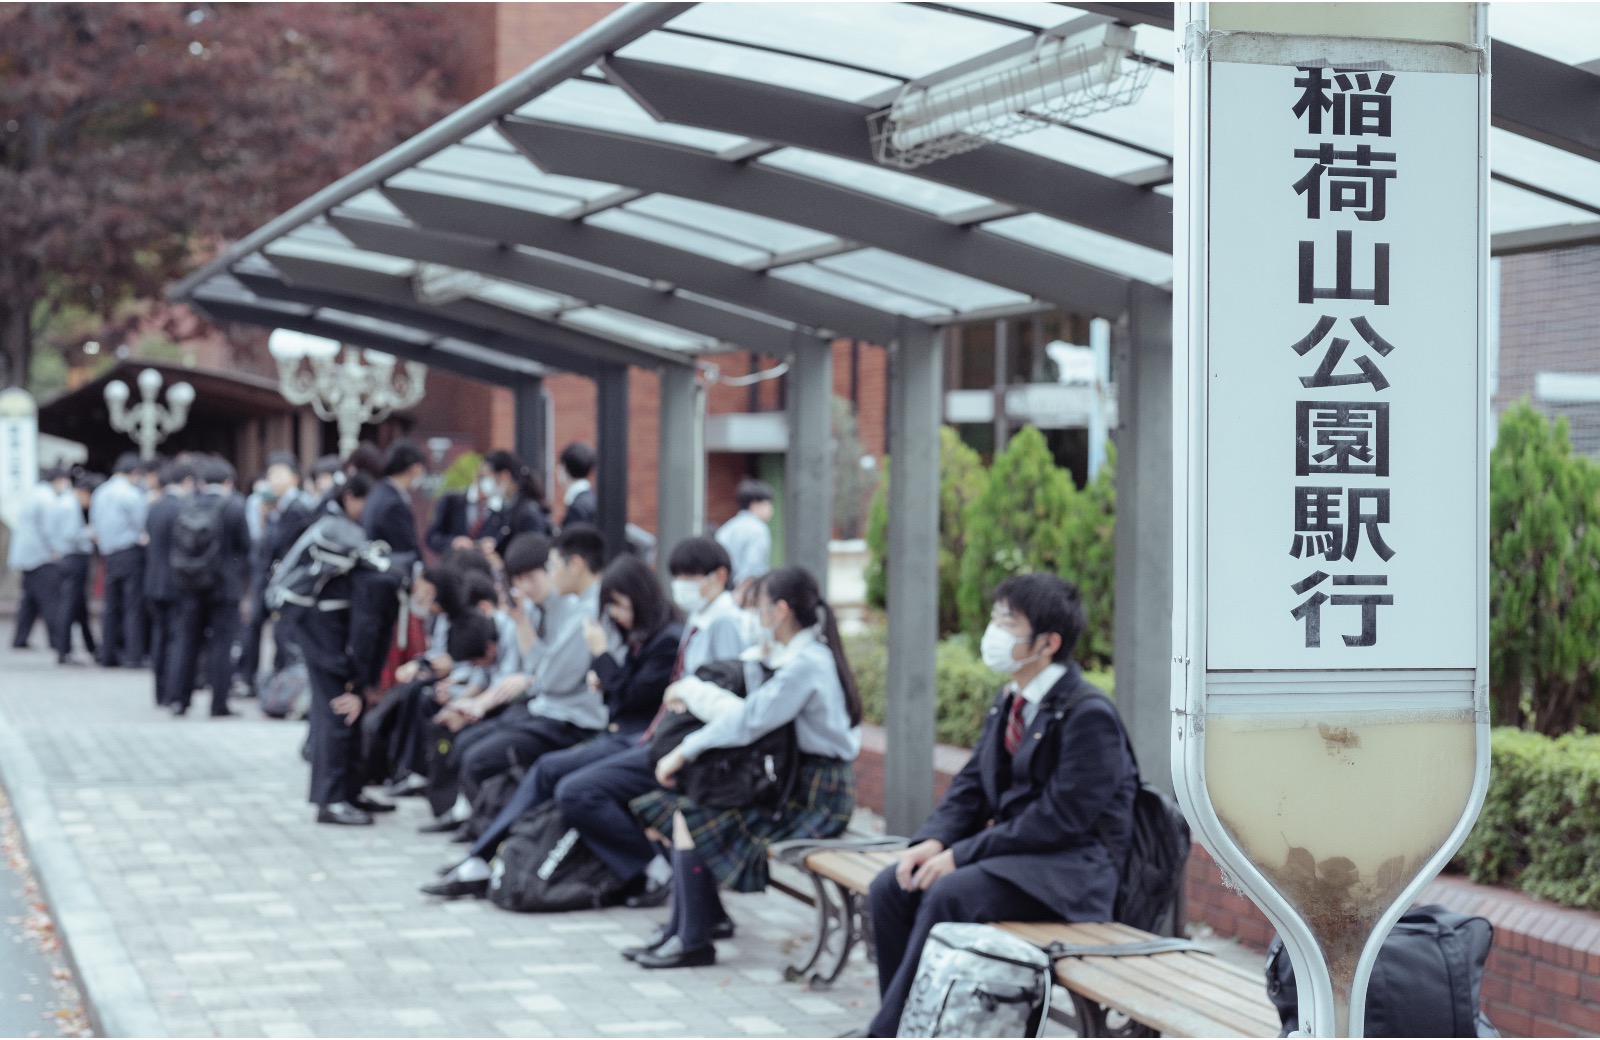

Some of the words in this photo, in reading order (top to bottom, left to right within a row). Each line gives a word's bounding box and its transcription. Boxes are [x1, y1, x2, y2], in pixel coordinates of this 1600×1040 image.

[1289, 60, 1398, 648] 稲荷山公園駅行
